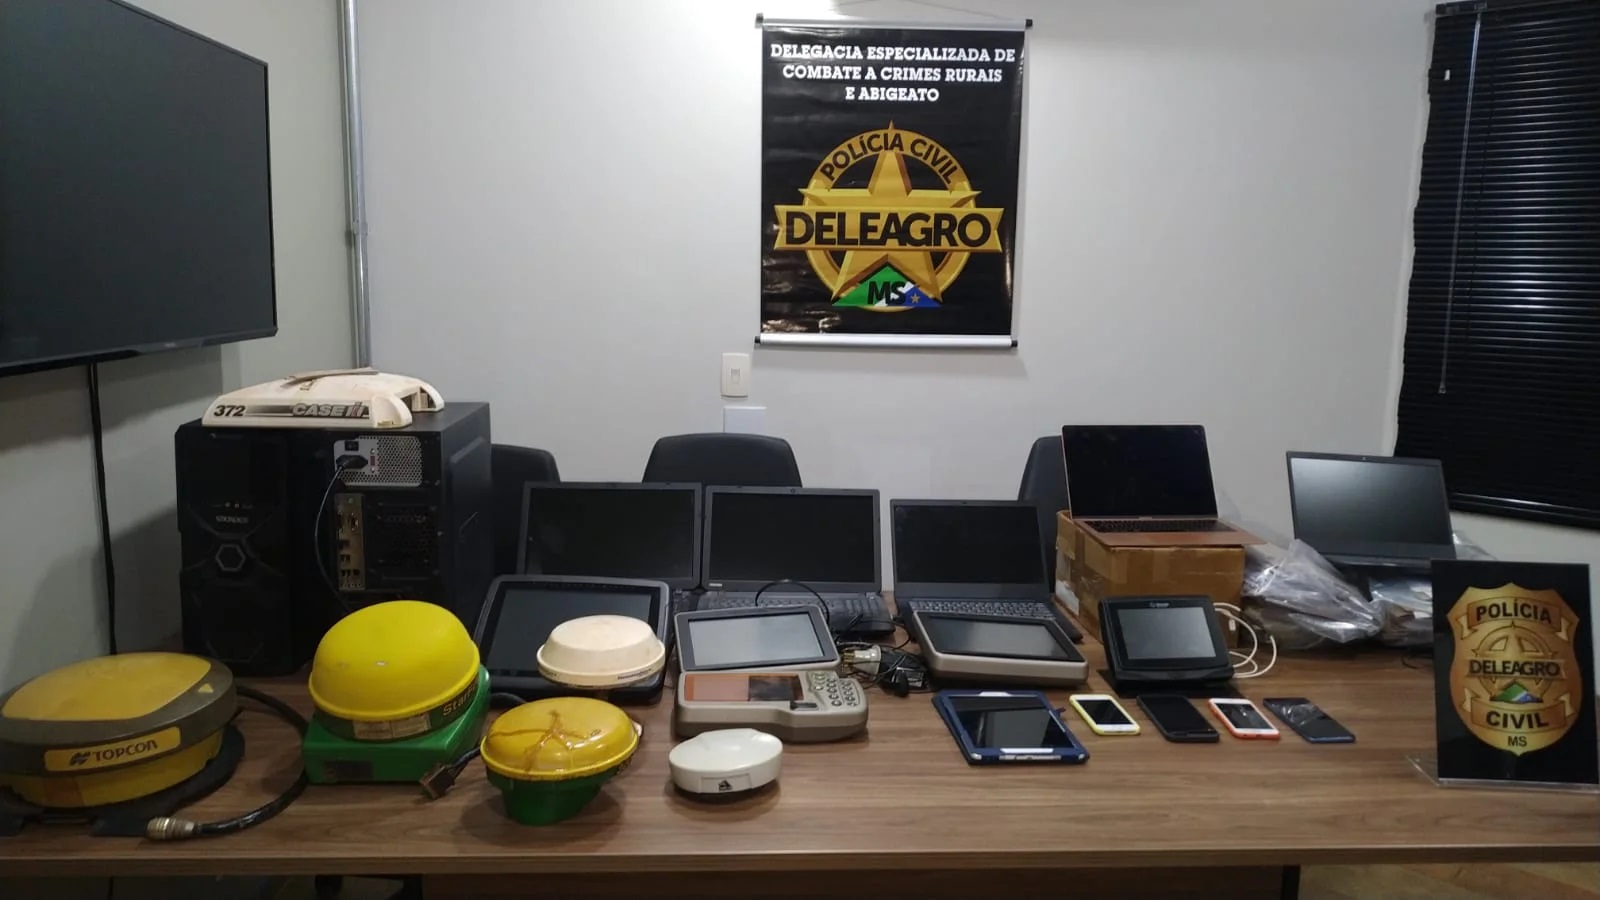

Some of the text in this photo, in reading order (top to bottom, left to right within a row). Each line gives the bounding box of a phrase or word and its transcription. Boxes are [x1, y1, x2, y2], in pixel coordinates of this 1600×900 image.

[770, 43, 1015, 62] DELEGACIA ESPECIALIZADA DE
[782, 64, 1002, 82] COMBATE A CRIMES RURAIS
[845, 86, 939, 101] E ABIGEATO
[820, 132, 957, 184] POLÍCIA CIVIL
[785, 211, 991, 247] DELEAGRO
[867, 281, 906, 305] MS
[214, 405, 246, 417] 372
[292, 403, 345, 417] CASE
[1476, 599, 1552, 624] POLÍCIA
[1469, 660, 1561, 676] DELEAGRO
[1486, 711, 1549, 729] CIVIL
[93, 739, 158, 761] TOPCON
[1508, 736, 1527, 747] MS
